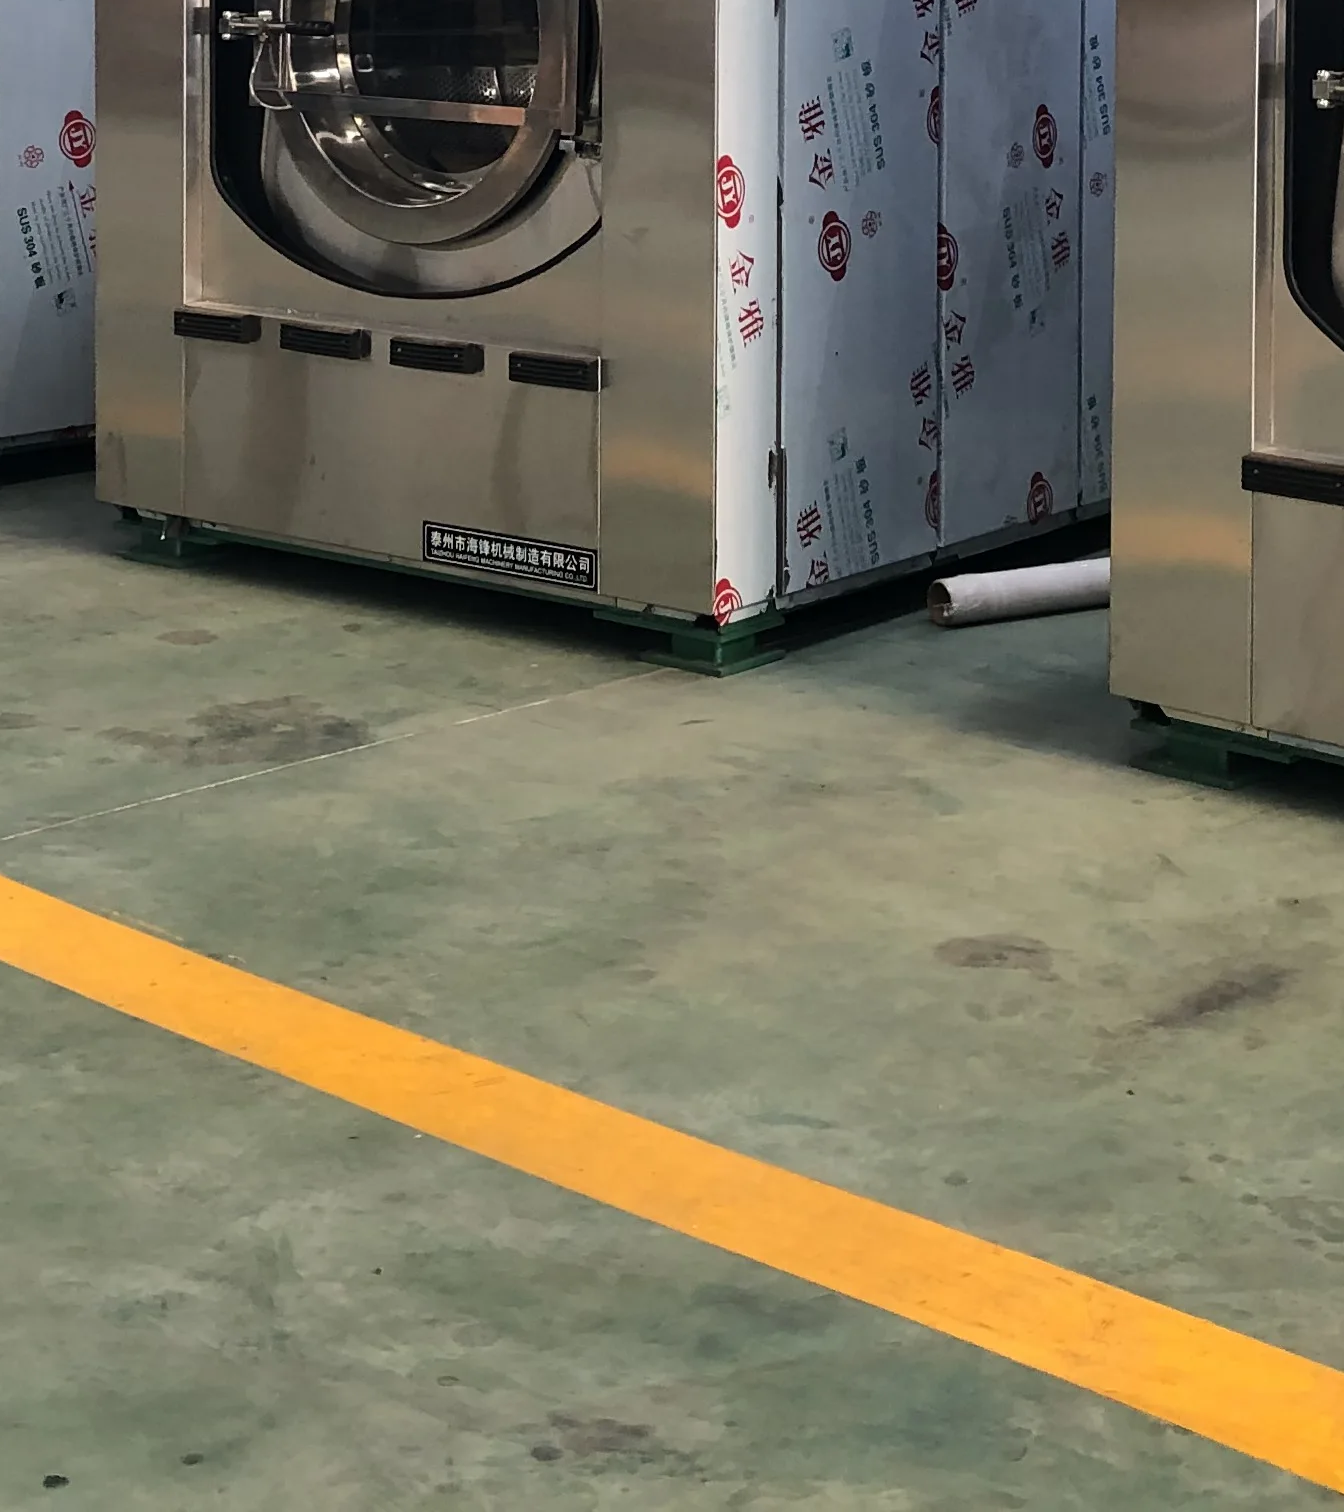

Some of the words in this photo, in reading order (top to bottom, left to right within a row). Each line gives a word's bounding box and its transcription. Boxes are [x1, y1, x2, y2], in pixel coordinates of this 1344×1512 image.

[868, 103, 880, 132] 304
[798, 95, 836, 190] 金雅
[873, 134, 886, 171] SUS
[16, 207, 32, 237] SUS
[23, 235, 38, 259] 304
[729, 249, 764, 348] 金雅
[863, 499, 874, 530] 304
[430, 530, 590, 574] 泰州市海锋机械制造有限公司
[867, 530, 880, 565] SUS
